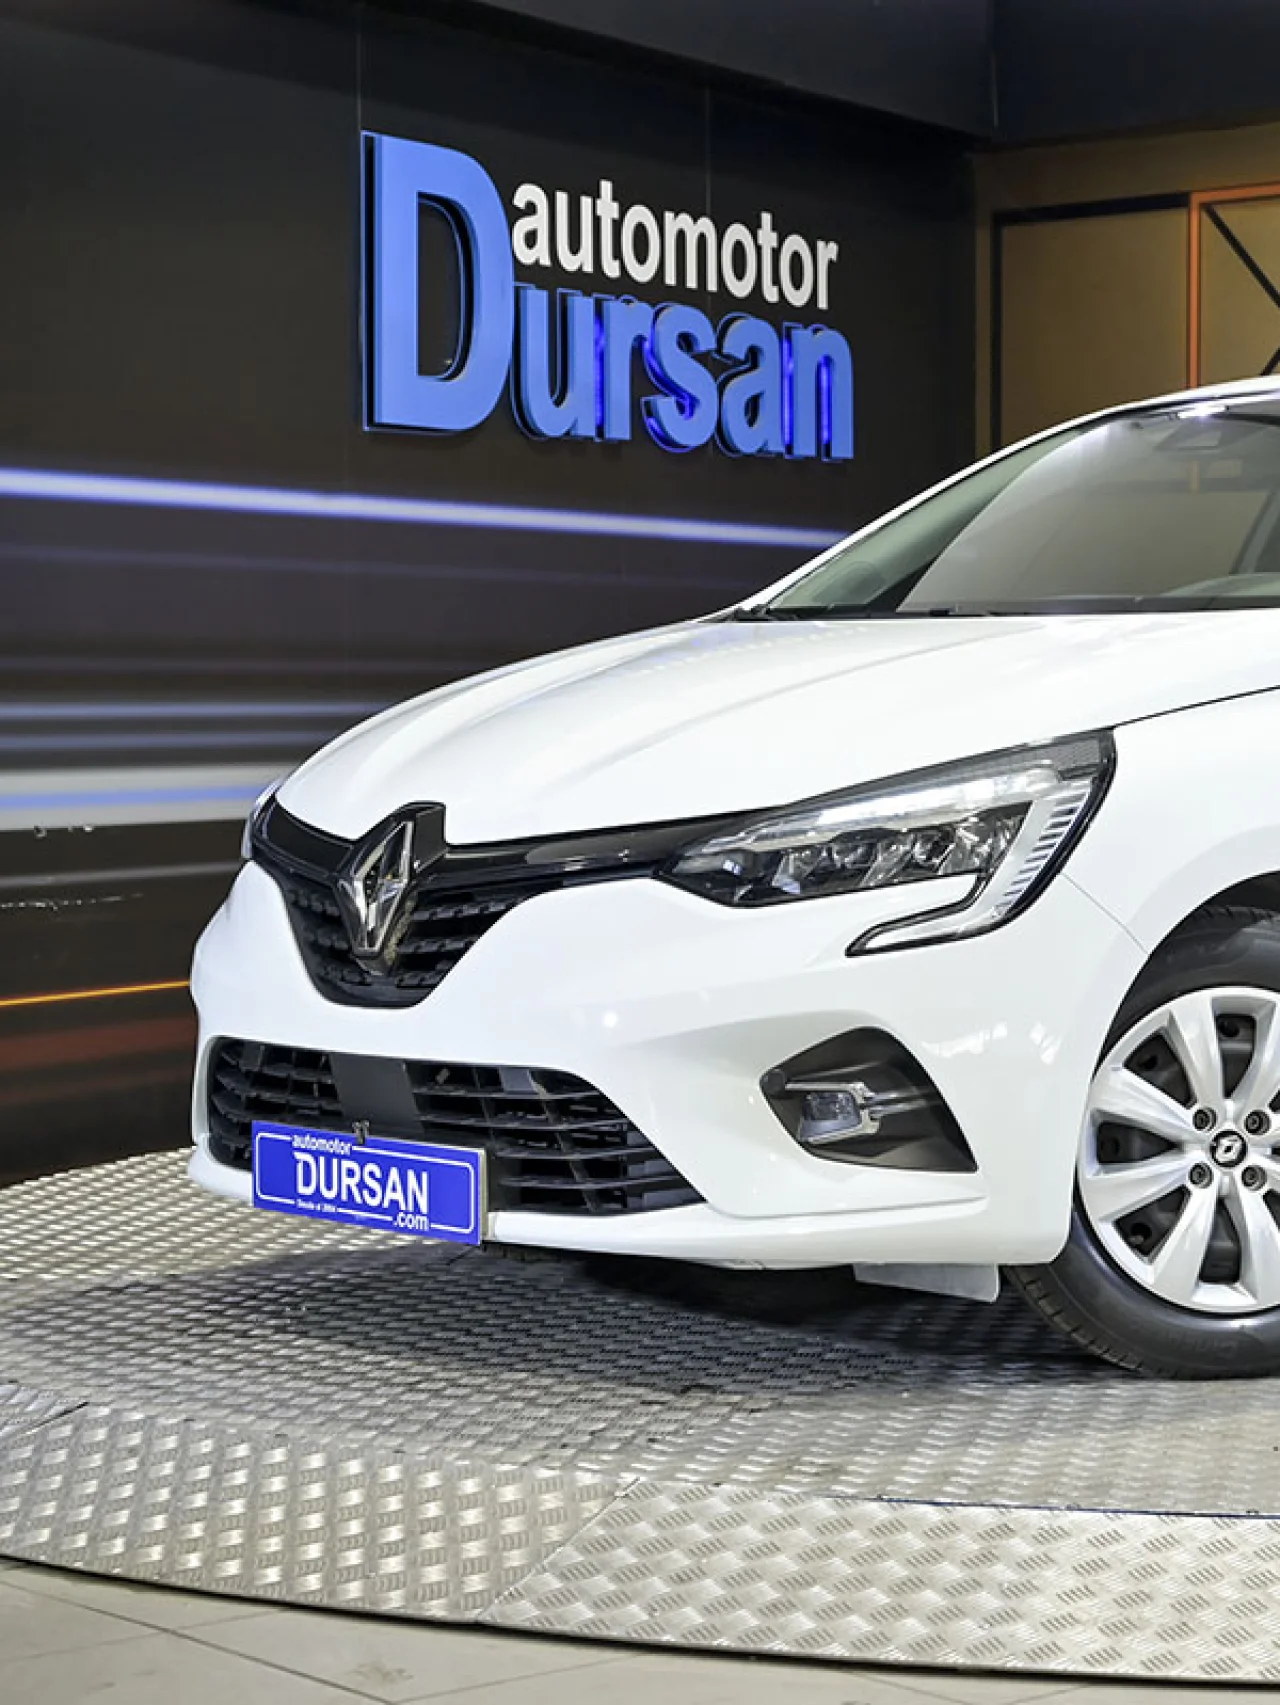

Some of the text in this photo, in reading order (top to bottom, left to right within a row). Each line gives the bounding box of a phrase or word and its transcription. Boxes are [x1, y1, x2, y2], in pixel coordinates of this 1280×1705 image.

[512, 179, 839, 309] automotor
[361, 130, 854, 461] Dursan
[292, 1135, 352, 1155] automotor
[294, 1151, 428, 1215] DURSAN
[393, 1210, 428, 1231] .com
